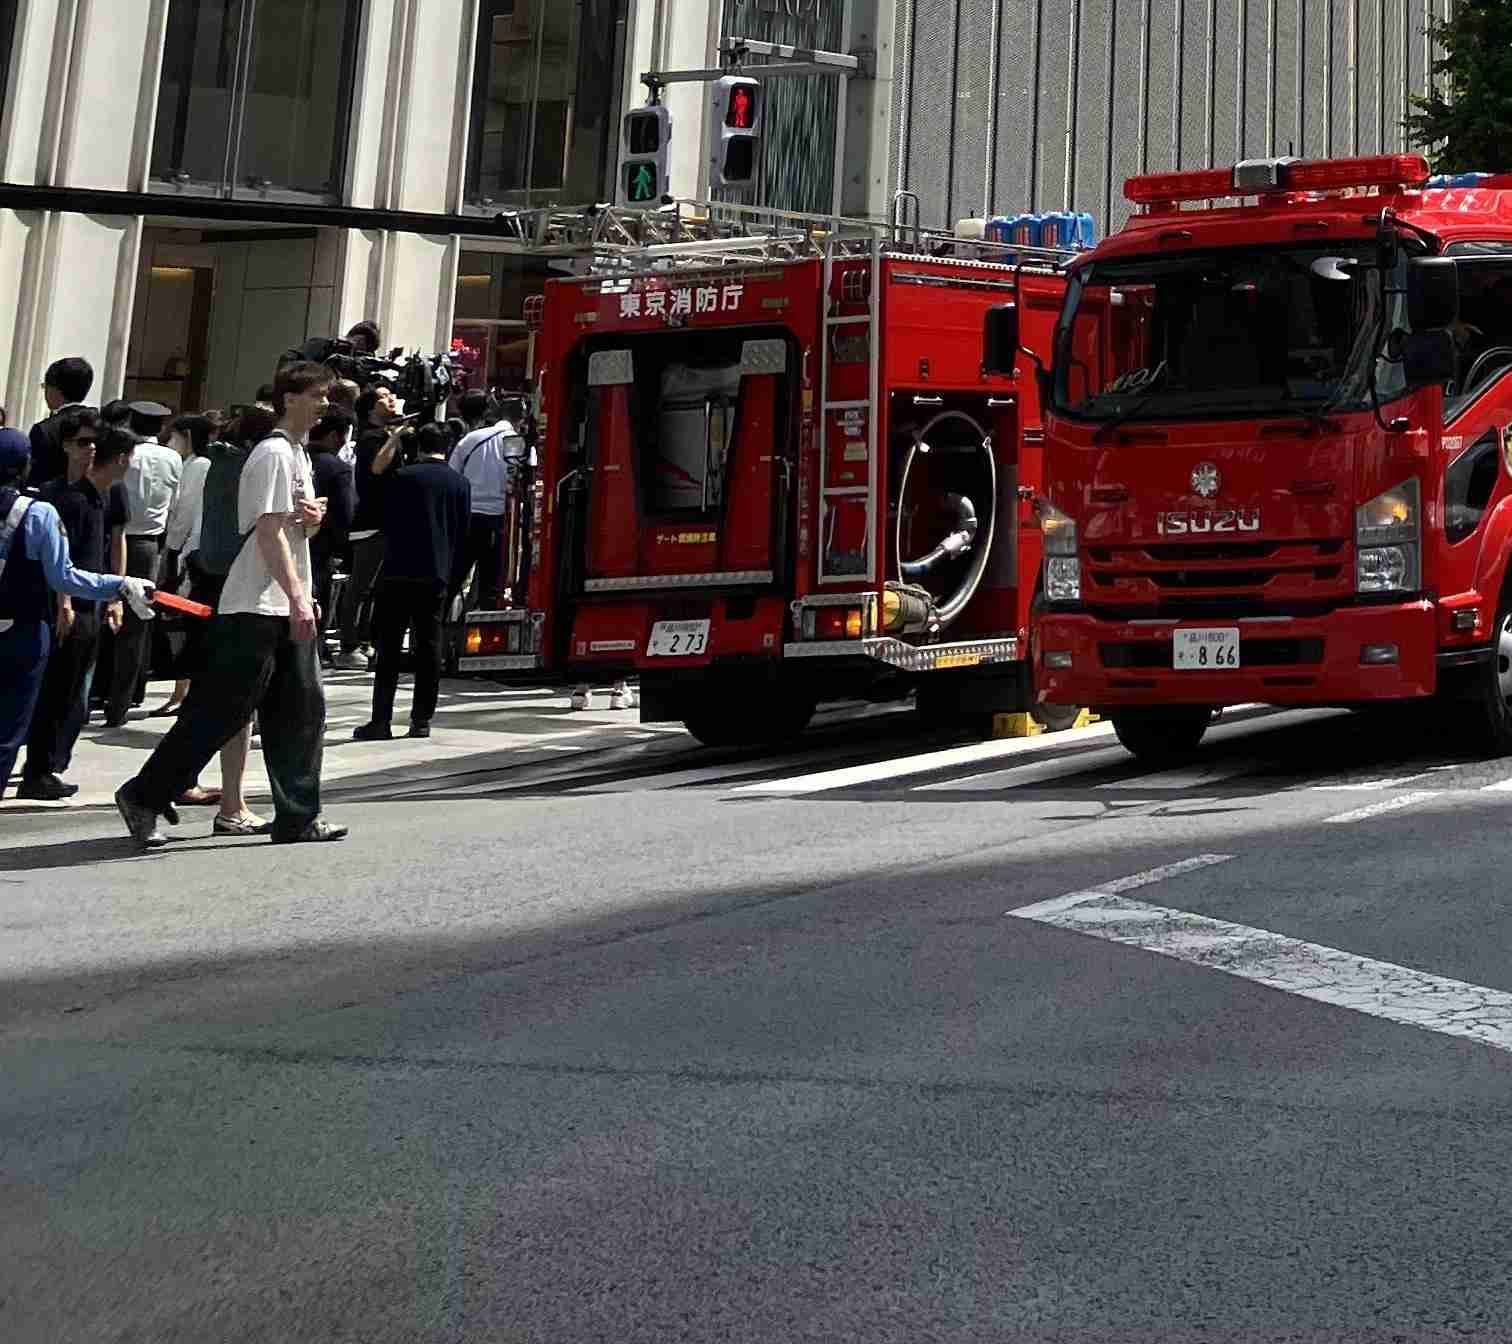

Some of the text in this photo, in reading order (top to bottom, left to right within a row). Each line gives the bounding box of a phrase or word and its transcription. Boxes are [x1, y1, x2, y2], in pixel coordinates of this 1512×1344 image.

[618, 284, 744, 318] 東京消防庁
[1156, 507, 1260, 535] ISUZU
